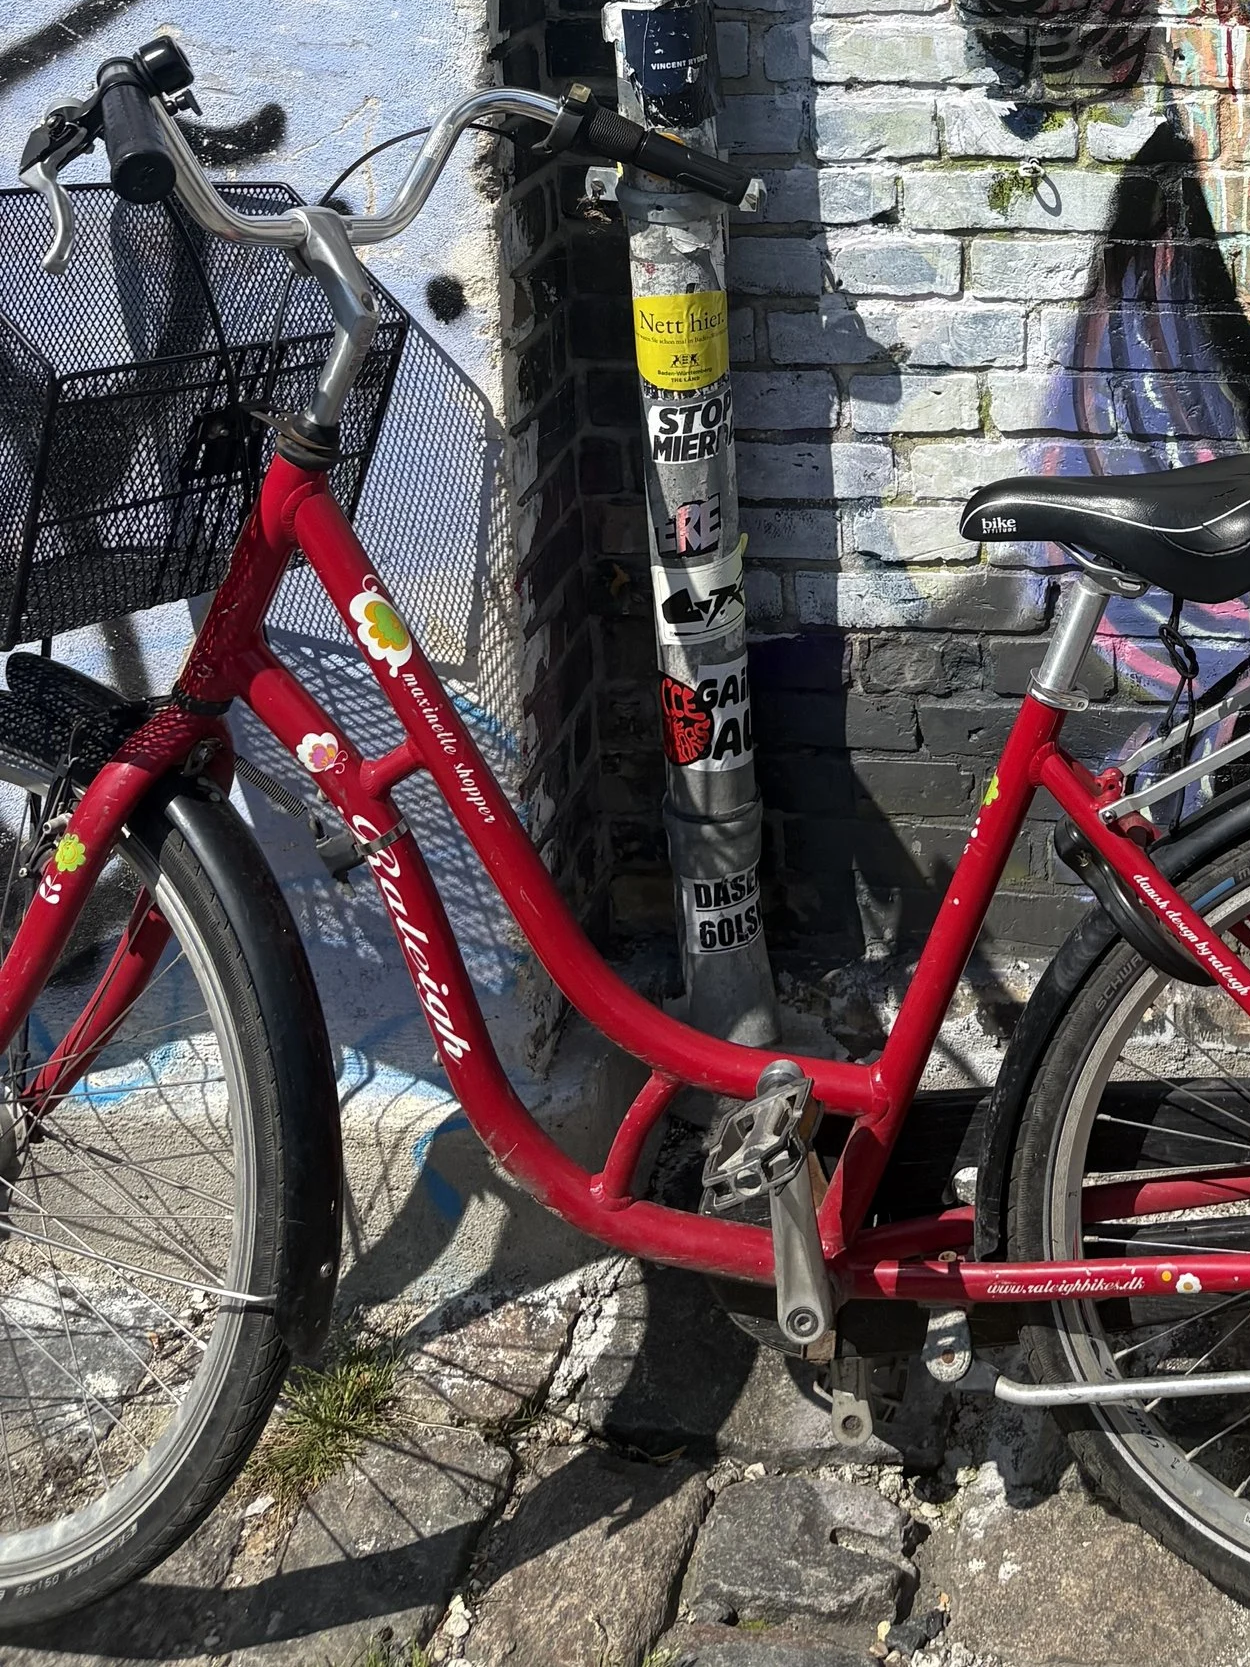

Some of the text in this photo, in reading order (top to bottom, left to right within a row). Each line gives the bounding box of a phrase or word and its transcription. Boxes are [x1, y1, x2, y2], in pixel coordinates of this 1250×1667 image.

[651, 55, 708, 71] VINCENT RYDER
[639, 310, 725, 334] Nett hier.
[658, 389, 732, 435] STOP
[981, 516, 1016, 529] bike
[400, 671, 497, 825] maxinette shopper
[1133, 873, 1169, 911] danish
[1165, 908, 1200, 943] design
[1194, 939, 1212, 956] by
[338, 805, 473, 1066] Raleigh
[987, 1265, 1146, 1296] www.raleighbikes.dk
